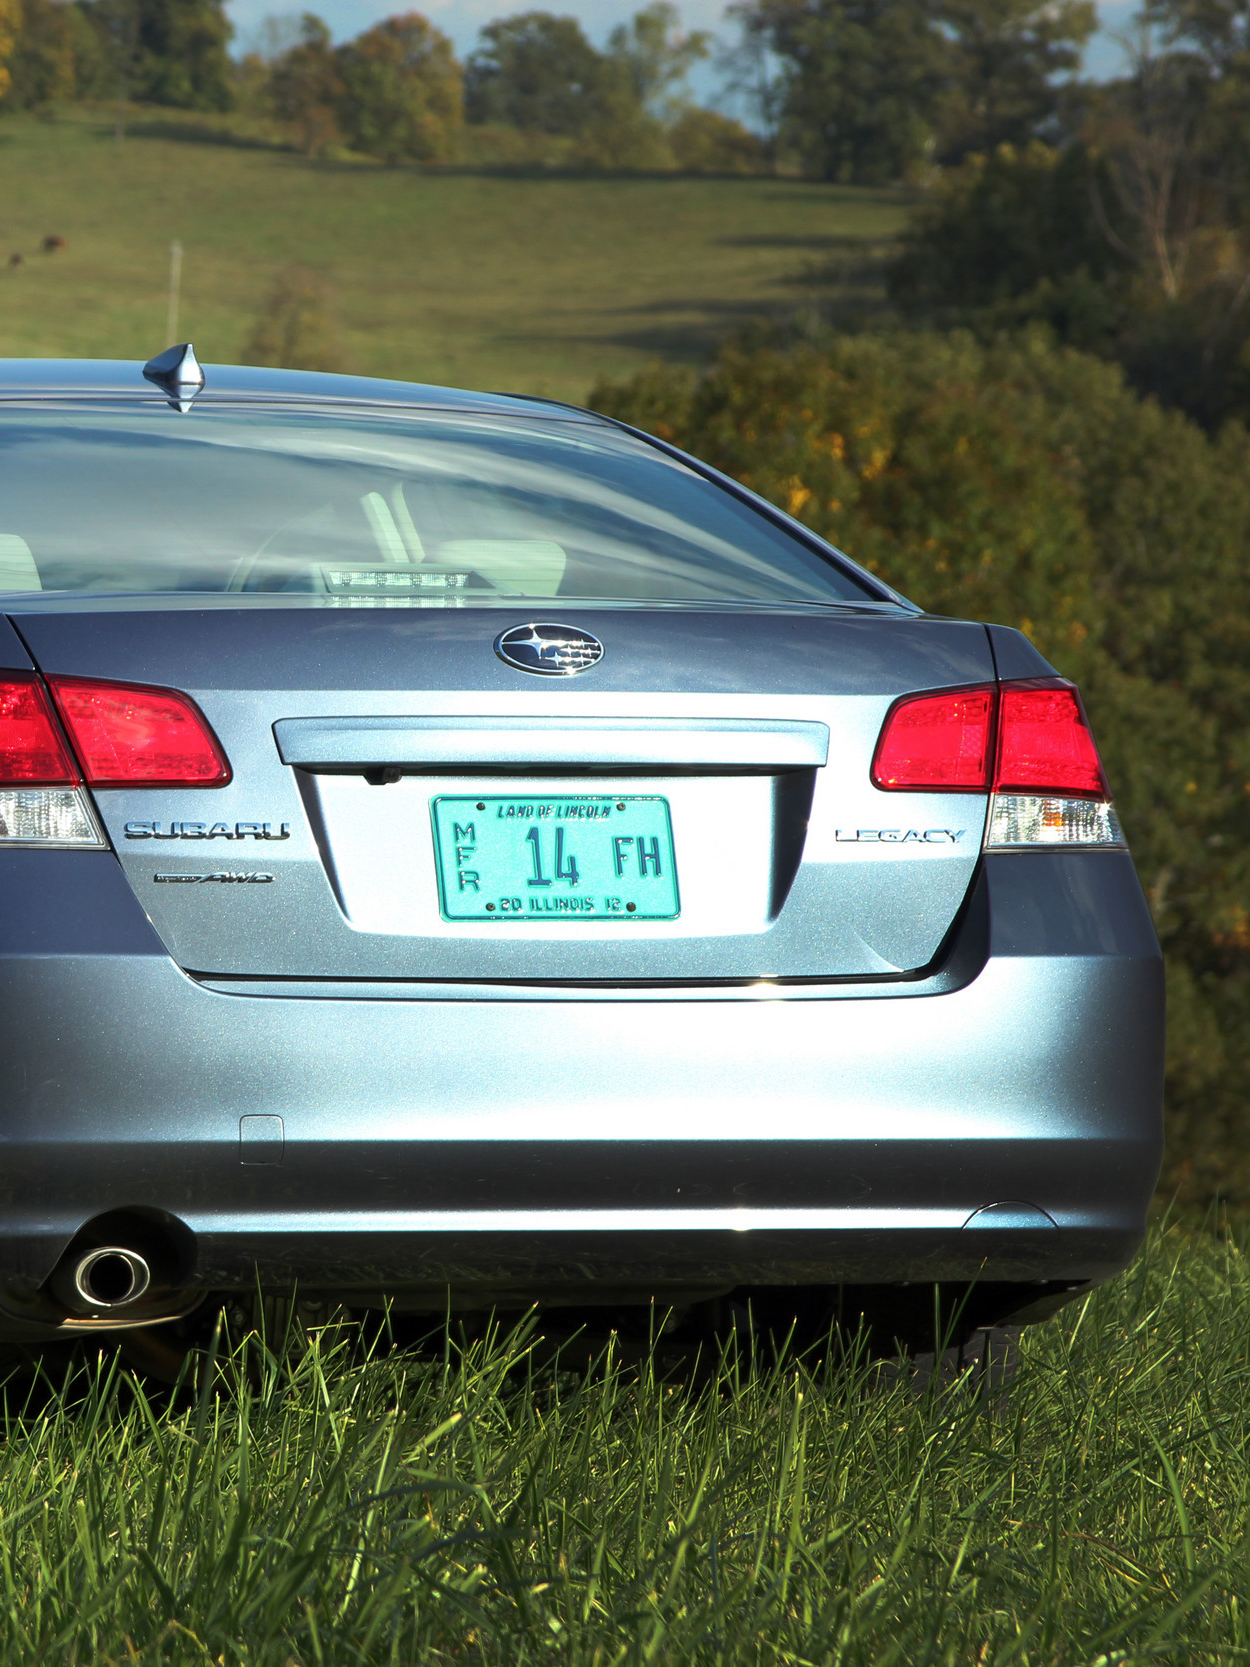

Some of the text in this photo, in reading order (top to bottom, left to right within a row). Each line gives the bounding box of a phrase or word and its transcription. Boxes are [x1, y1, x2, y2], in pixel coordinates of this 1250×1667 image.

[497, 805, 612, 818] LAND OF LINCOLN
[124, 821, 291, 840] SUBARU
[835, 829, 967, 843] LEGACY
[453, 822, 662, 891] MFR 14 FH
[199, 871, 276, 884] AWD
[501, 898, 621, 912] 20 ILLINOIS 12
